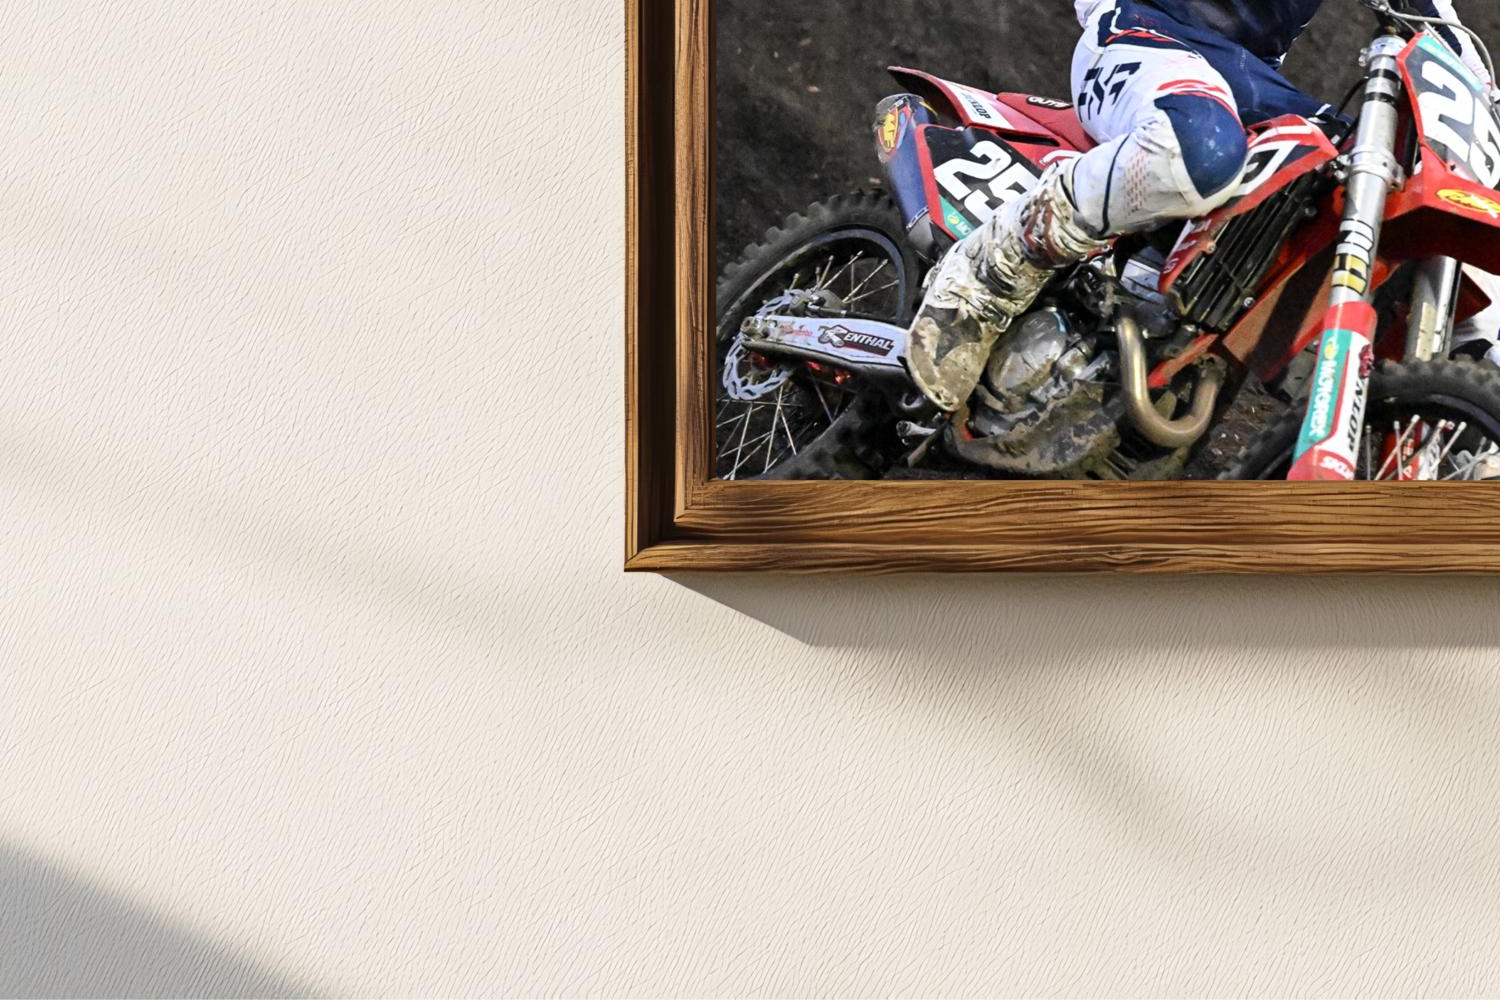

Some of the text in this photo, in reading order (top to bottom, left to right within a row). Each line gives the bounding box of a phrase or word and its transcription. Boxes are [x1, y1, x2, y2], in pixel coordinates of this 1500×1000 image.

[933, 140, 1041, 225] 25
[818, 325, 896, 351] RENTHAL
[1309, 359, 1337, 437] MOTOREX
[1347, 378, 1366, 453] NLOP
